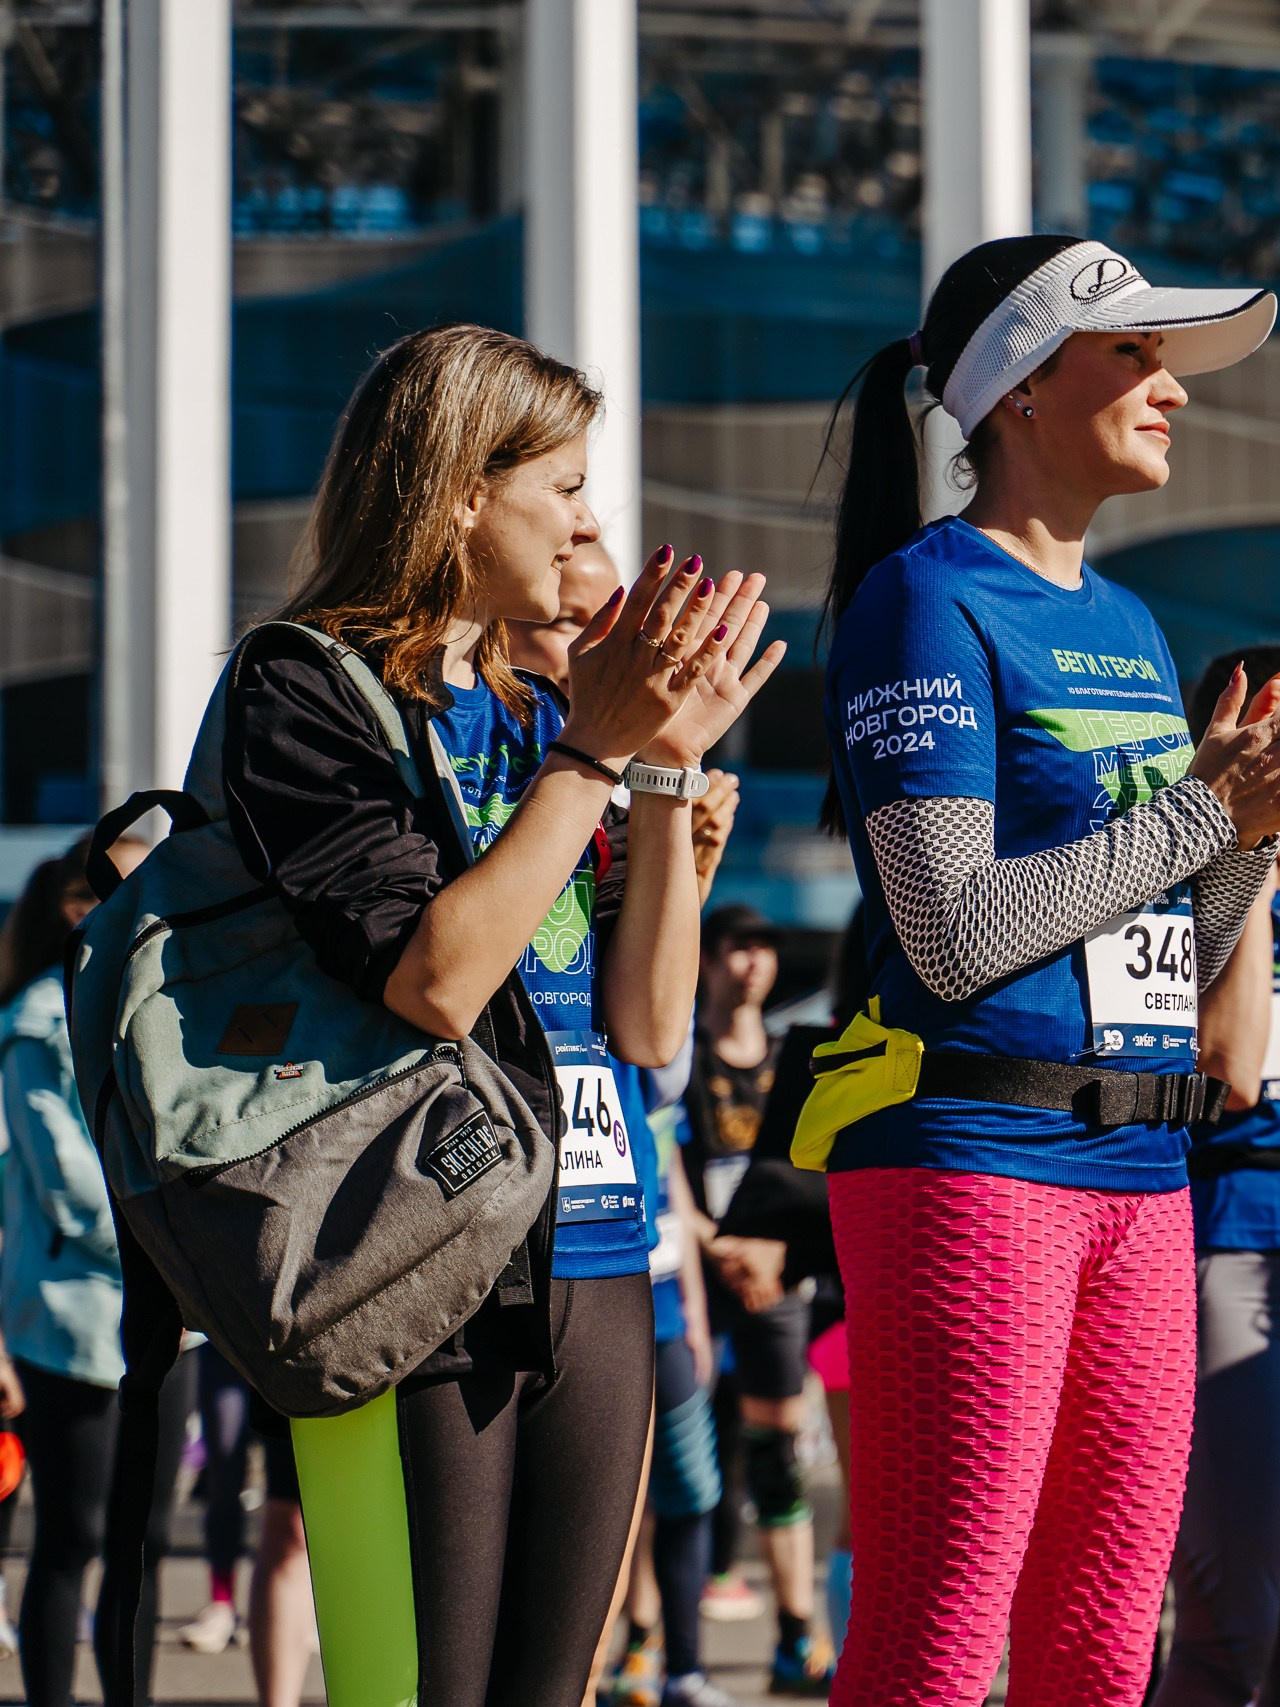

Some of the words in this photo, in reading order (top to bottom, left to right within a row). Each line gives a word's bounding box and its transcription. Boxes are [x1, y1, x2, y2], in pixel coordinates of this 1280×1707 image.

[847, 673, 962, 720] НИЖНИЙ
[845, 704, 978, 750] НОВГОРОД
[872, 730, 935, 760] 2024
[1124, 924, 1197, 983] 348
[441, 1125, 497, 1176] SKECHERS
